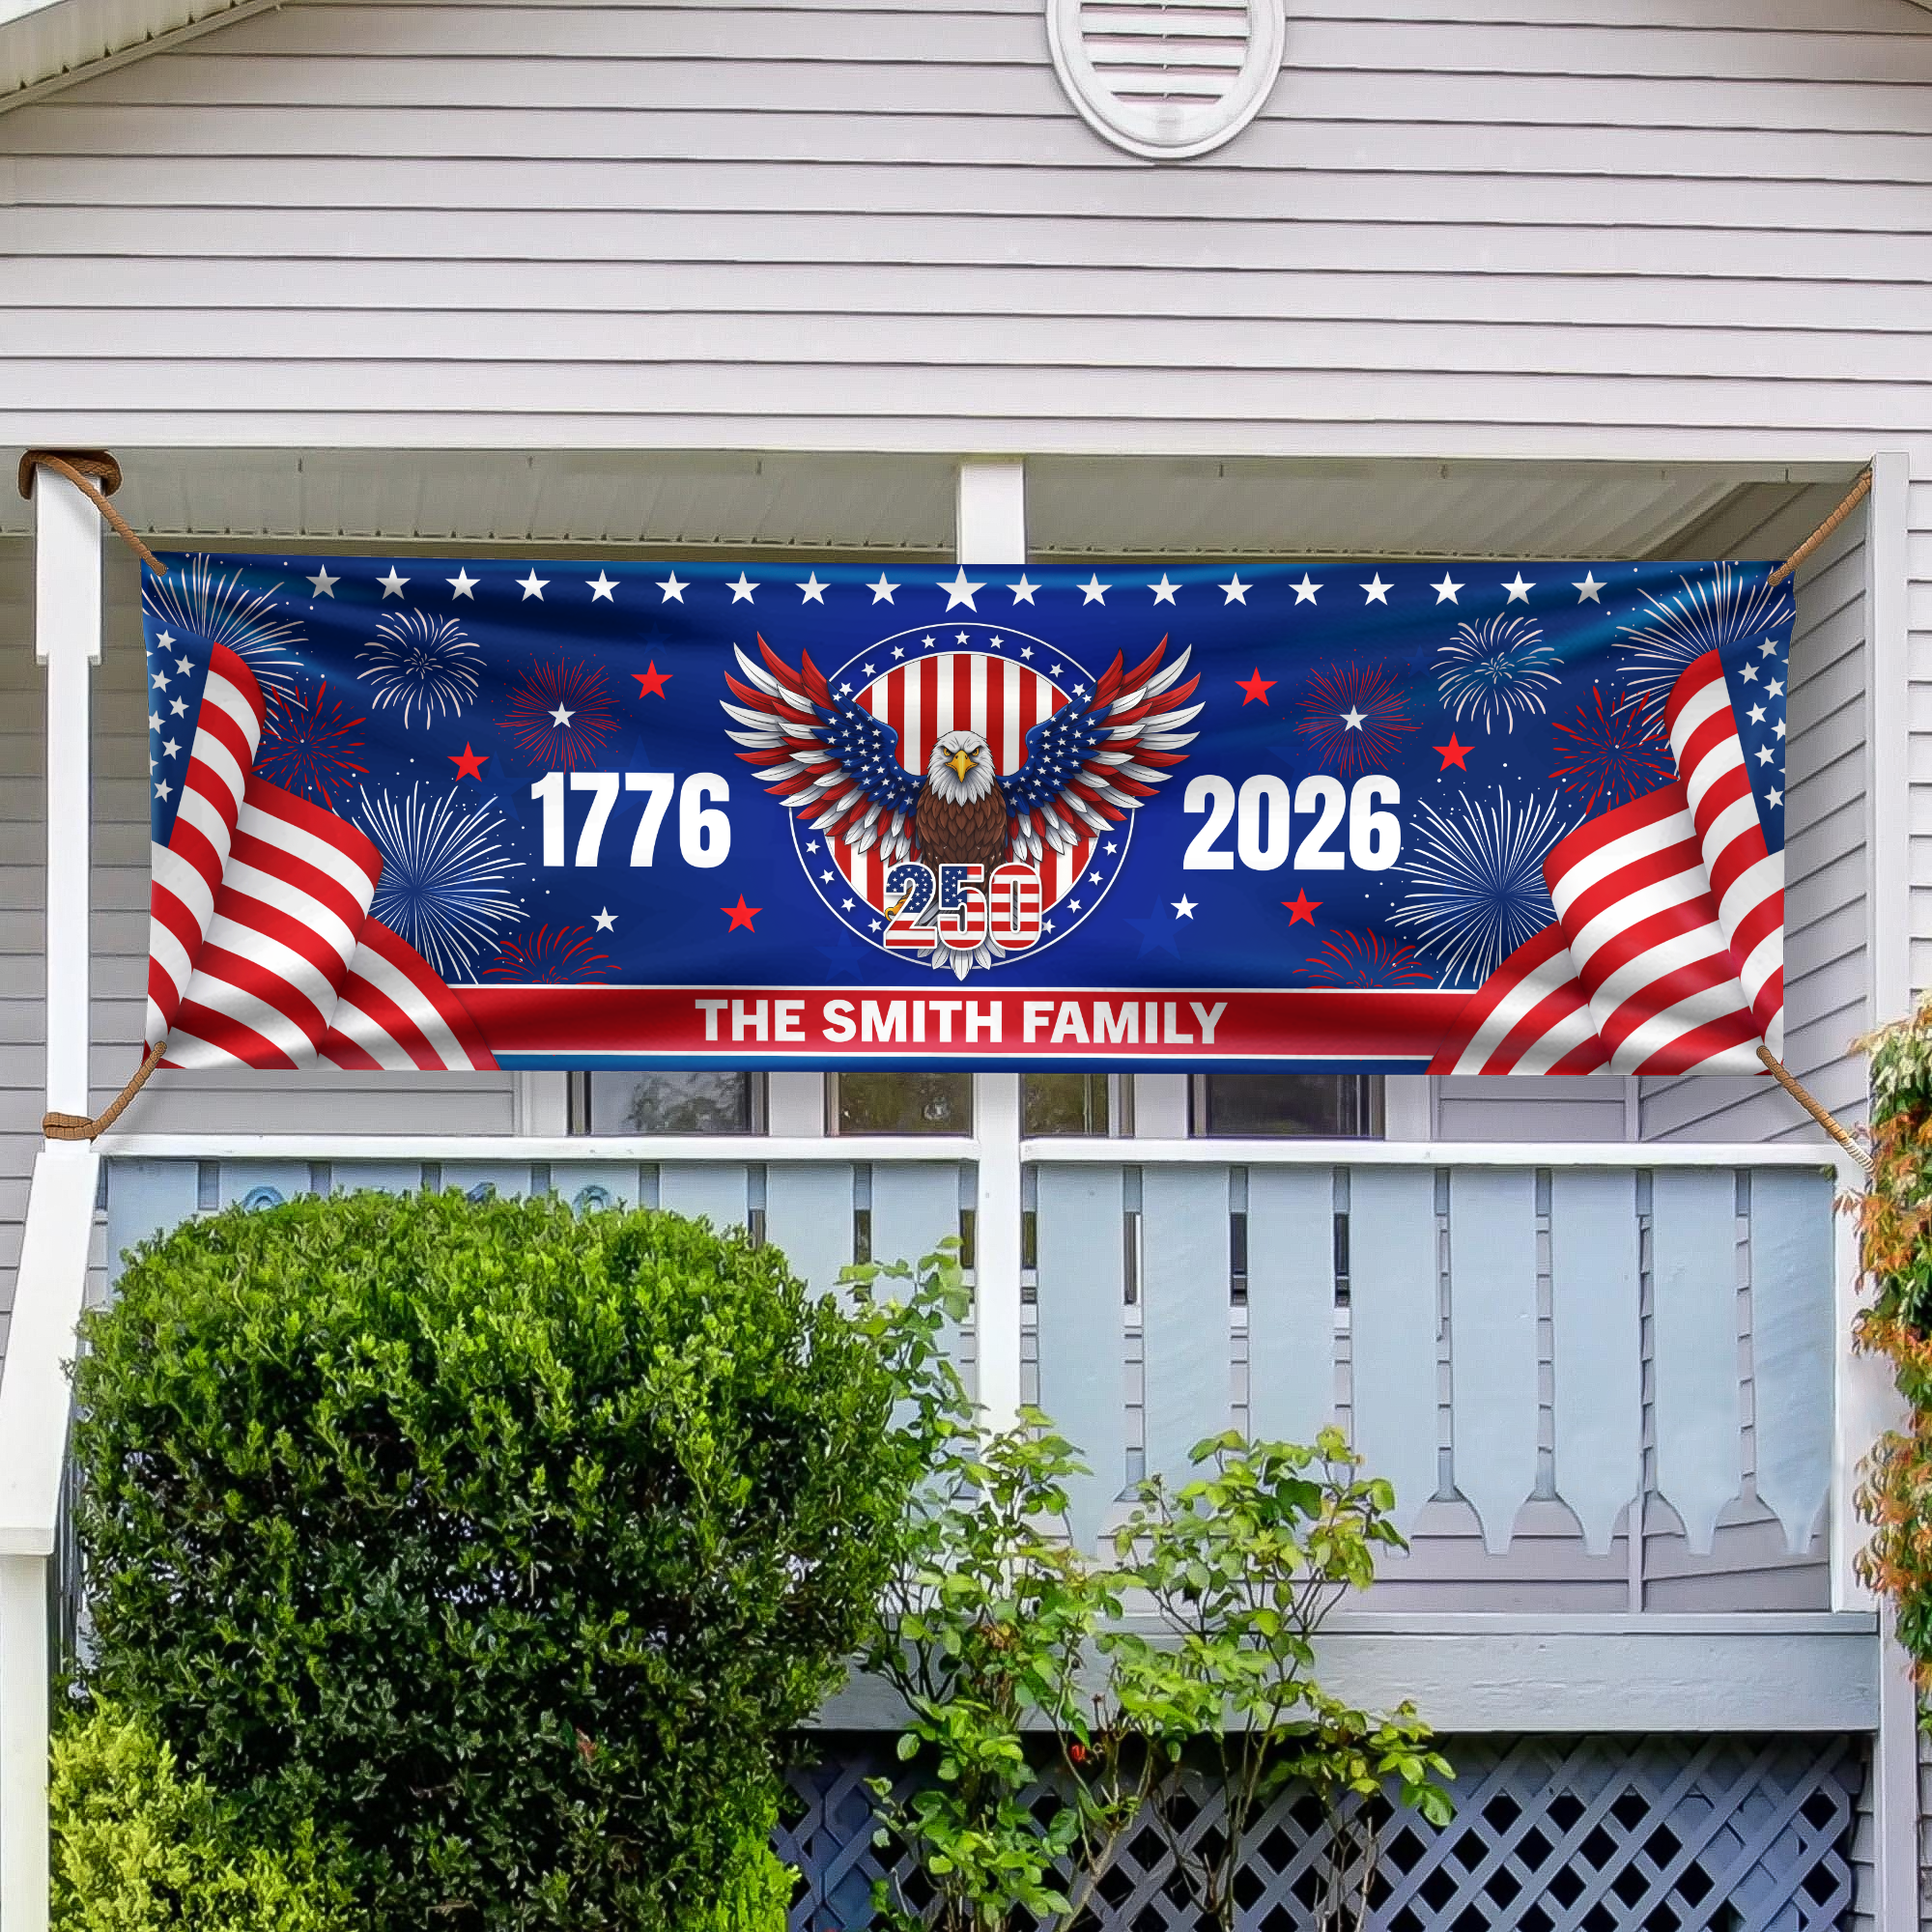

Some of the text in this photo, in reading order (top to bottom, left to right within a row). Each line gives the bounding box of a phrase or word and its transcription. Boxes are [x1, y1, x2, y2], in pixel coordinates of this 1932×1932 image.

[531, 772, 731, 868] 1776
[1182, 774, 1402, 871] 2026
[883, 862, 1042, 952] 250
[695, 999, 1229, 1045] THE SMITH FAMILY
